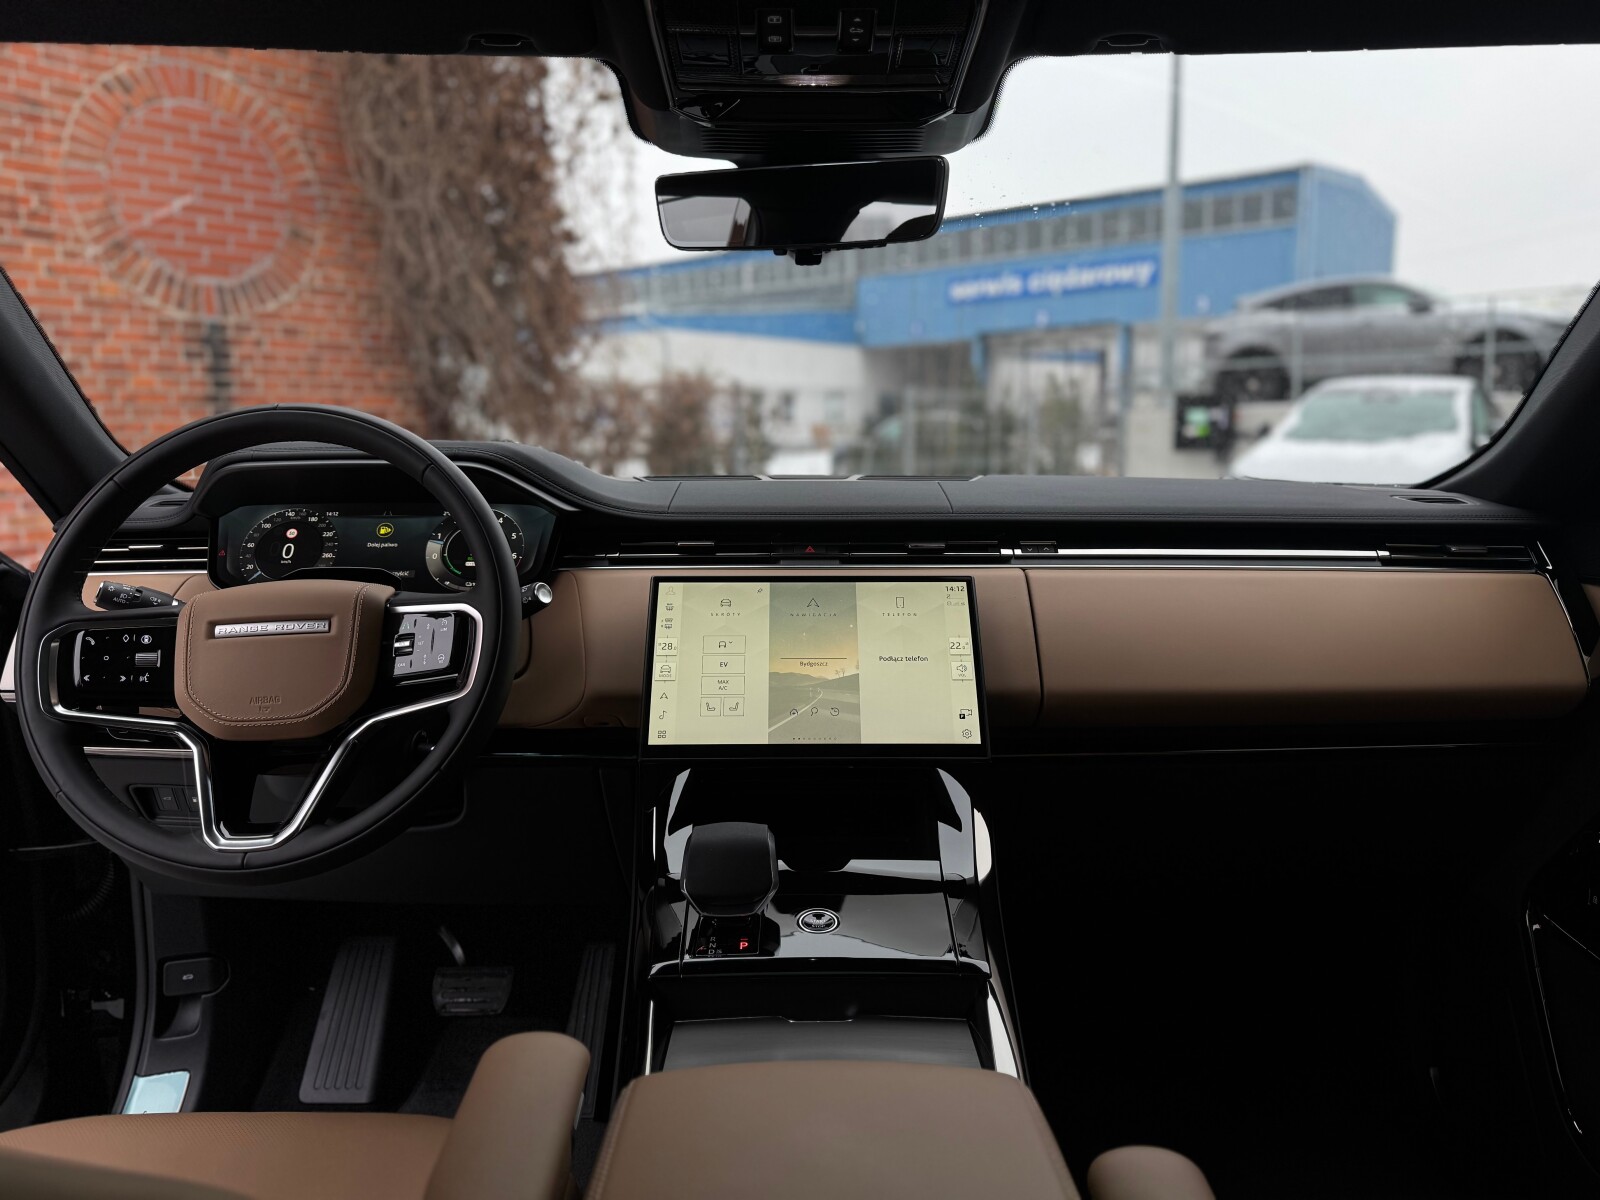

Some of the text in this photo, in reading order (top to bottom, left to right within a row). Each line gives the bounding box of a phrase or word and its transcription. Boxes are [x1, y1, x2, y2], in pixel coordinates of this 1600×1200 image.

[281, 543, 295, 559] 0
[218, 621, 327, 635] RANGE ROVER
[879, 655, 904, 663] Podłącz
[249, 696, 282, 705] AIRBAG
[740, 941, 749, 950] P
